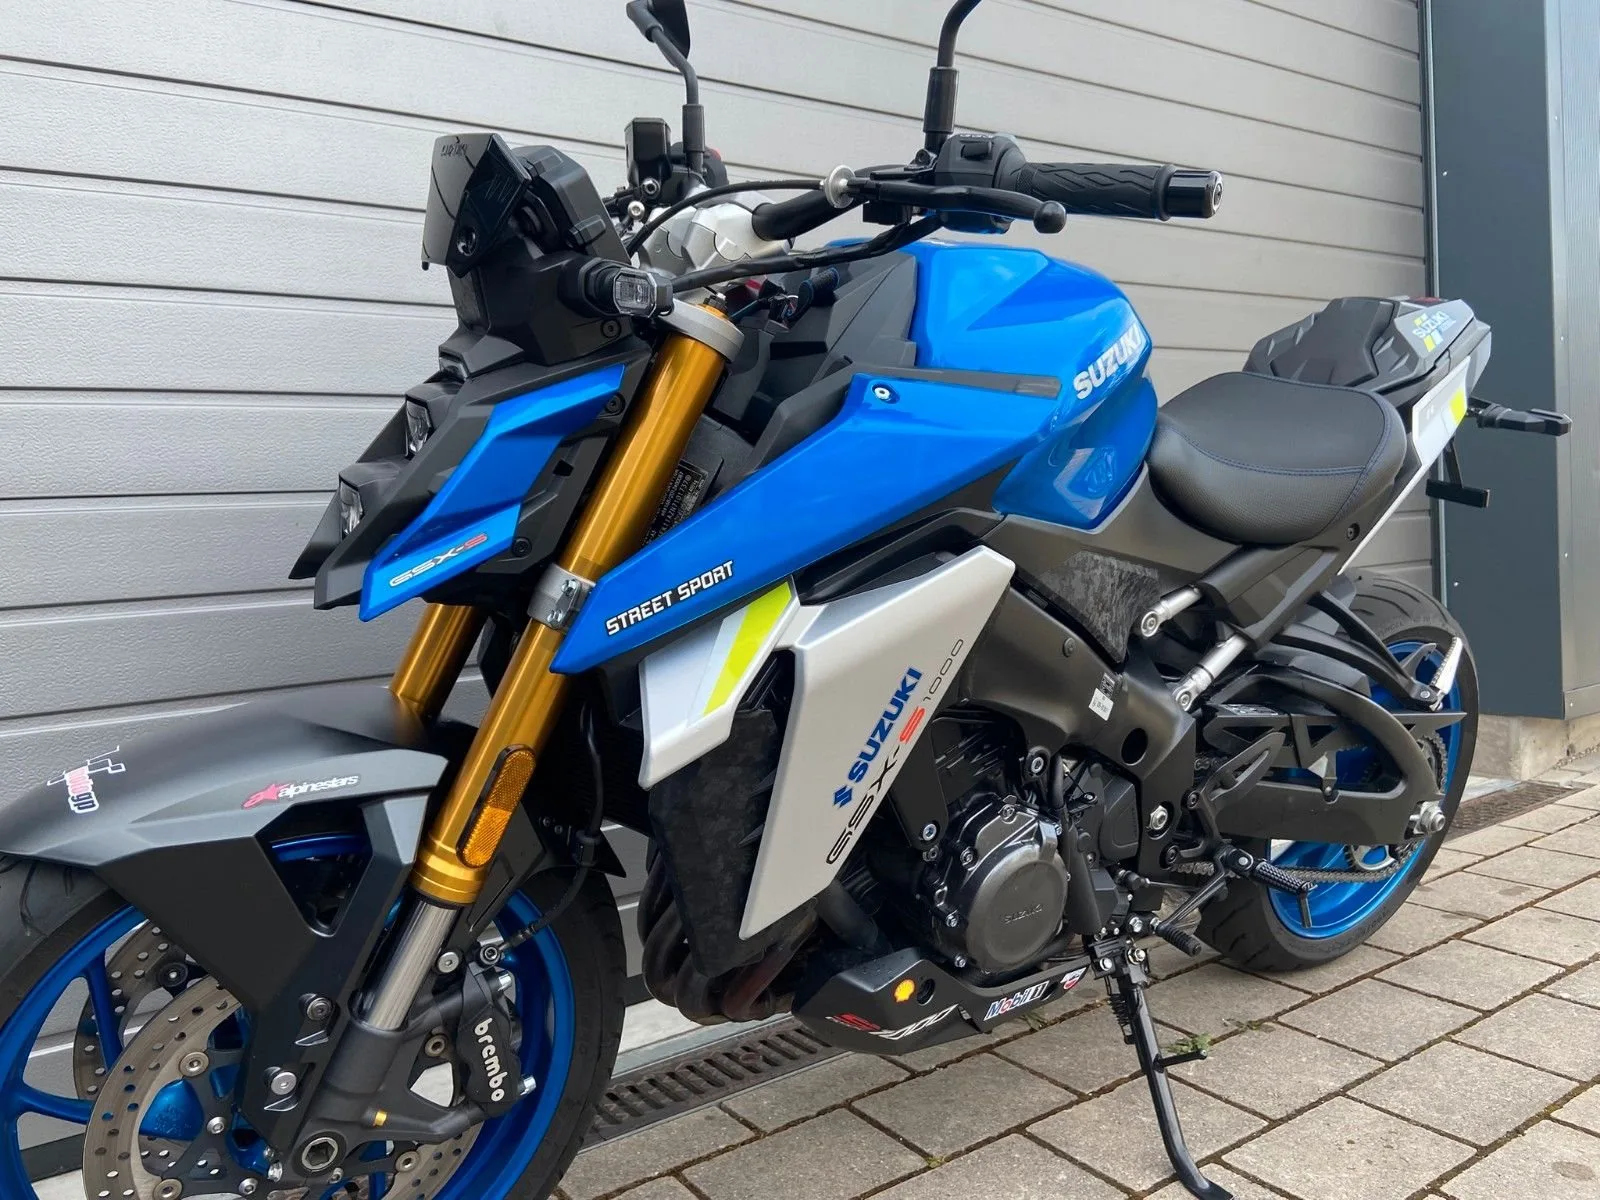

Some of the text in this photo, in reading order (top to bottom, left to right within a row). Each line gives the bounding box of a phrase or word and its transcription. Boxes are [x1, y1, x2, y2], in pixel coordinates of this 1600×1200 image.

[1073, 323, 1142, 399] SUZUKI
[1412, 311, 1450, 338] SUZUKI
[605, 560, 733, 636] STREET SPORT
[848, 666, 923, 784] SUZUKI
[278, 775, 359, 799] alpinestars
[984, 985, 1034, 1020] Mobil
[474, 1017, 508, 1102] brembo
